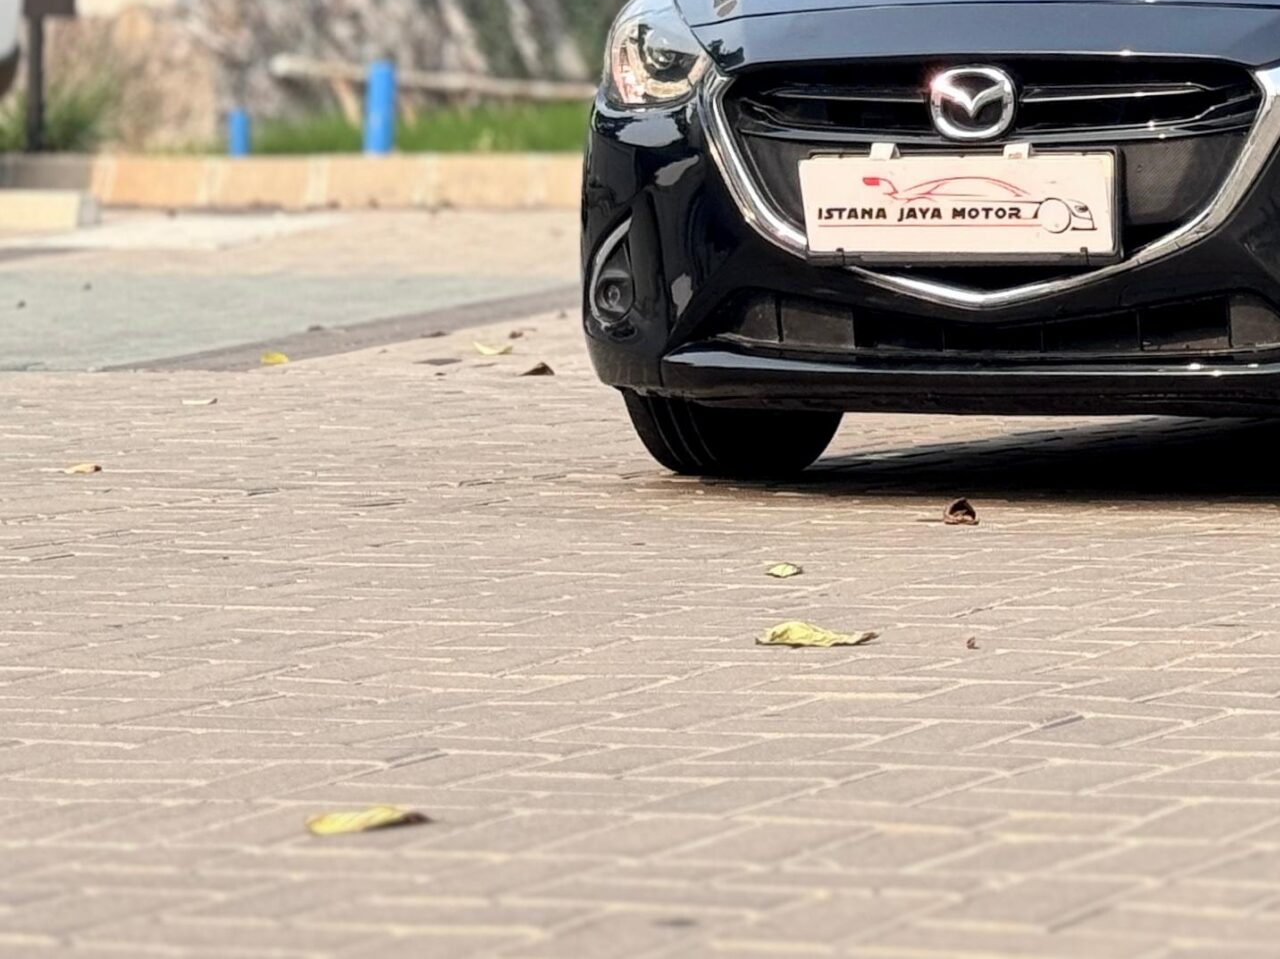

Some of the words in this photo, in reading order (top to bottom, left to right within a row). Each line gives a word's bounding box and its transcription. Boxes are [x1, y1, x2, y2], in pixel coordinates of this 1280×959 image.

[818, 207, 887, 221] ISTANA
[897, 207, 942, 223] JAYA
[951, 207, 1022, 221] MOTOR
